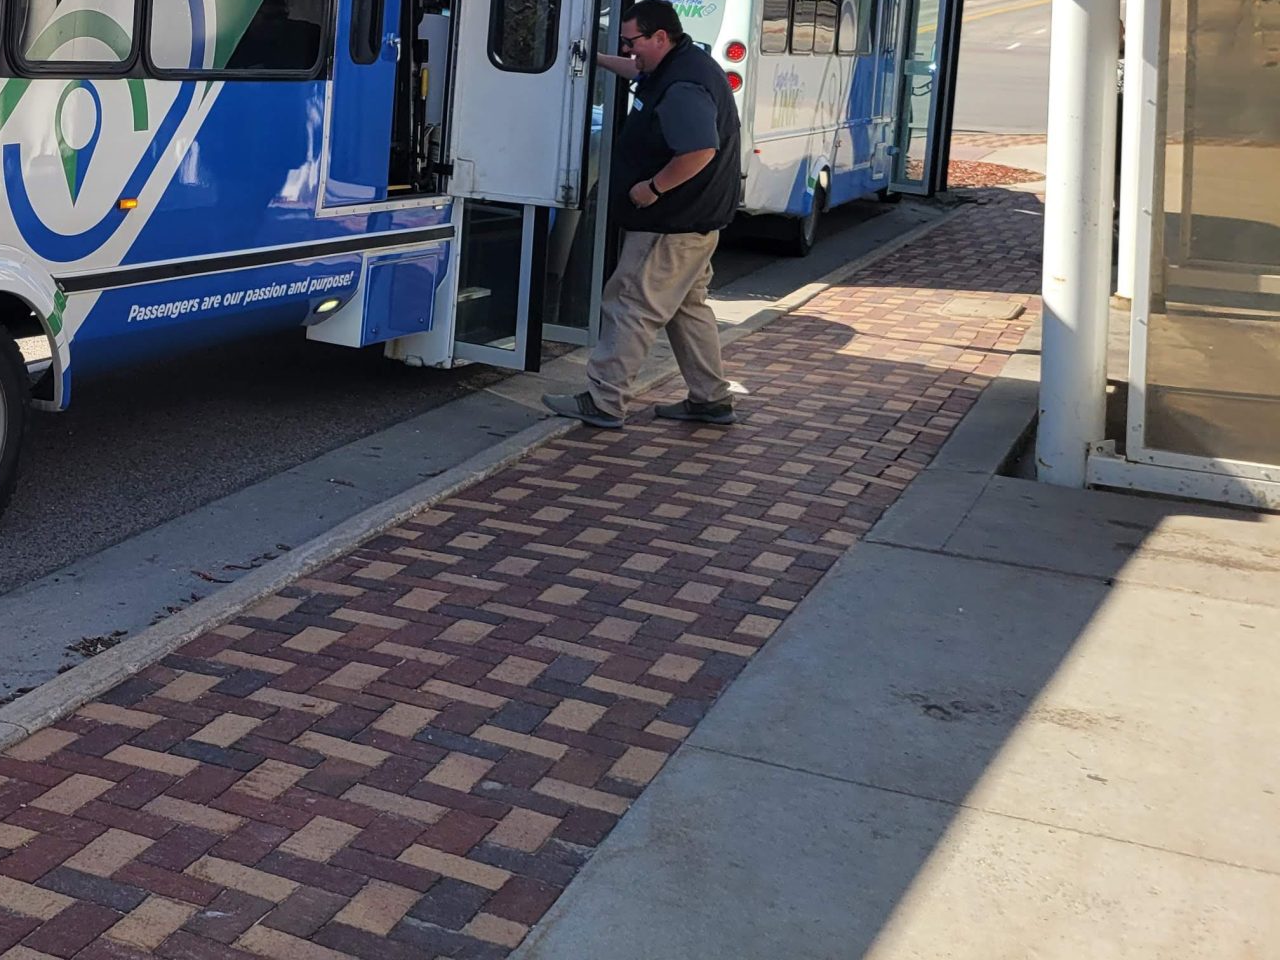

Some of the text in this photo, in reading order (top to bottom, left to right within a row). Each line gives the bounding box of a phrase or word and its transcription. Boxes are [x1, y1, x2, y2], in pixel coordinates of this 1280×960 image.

[127, 270, 355, 323] Passengers are our passion and purpose!
